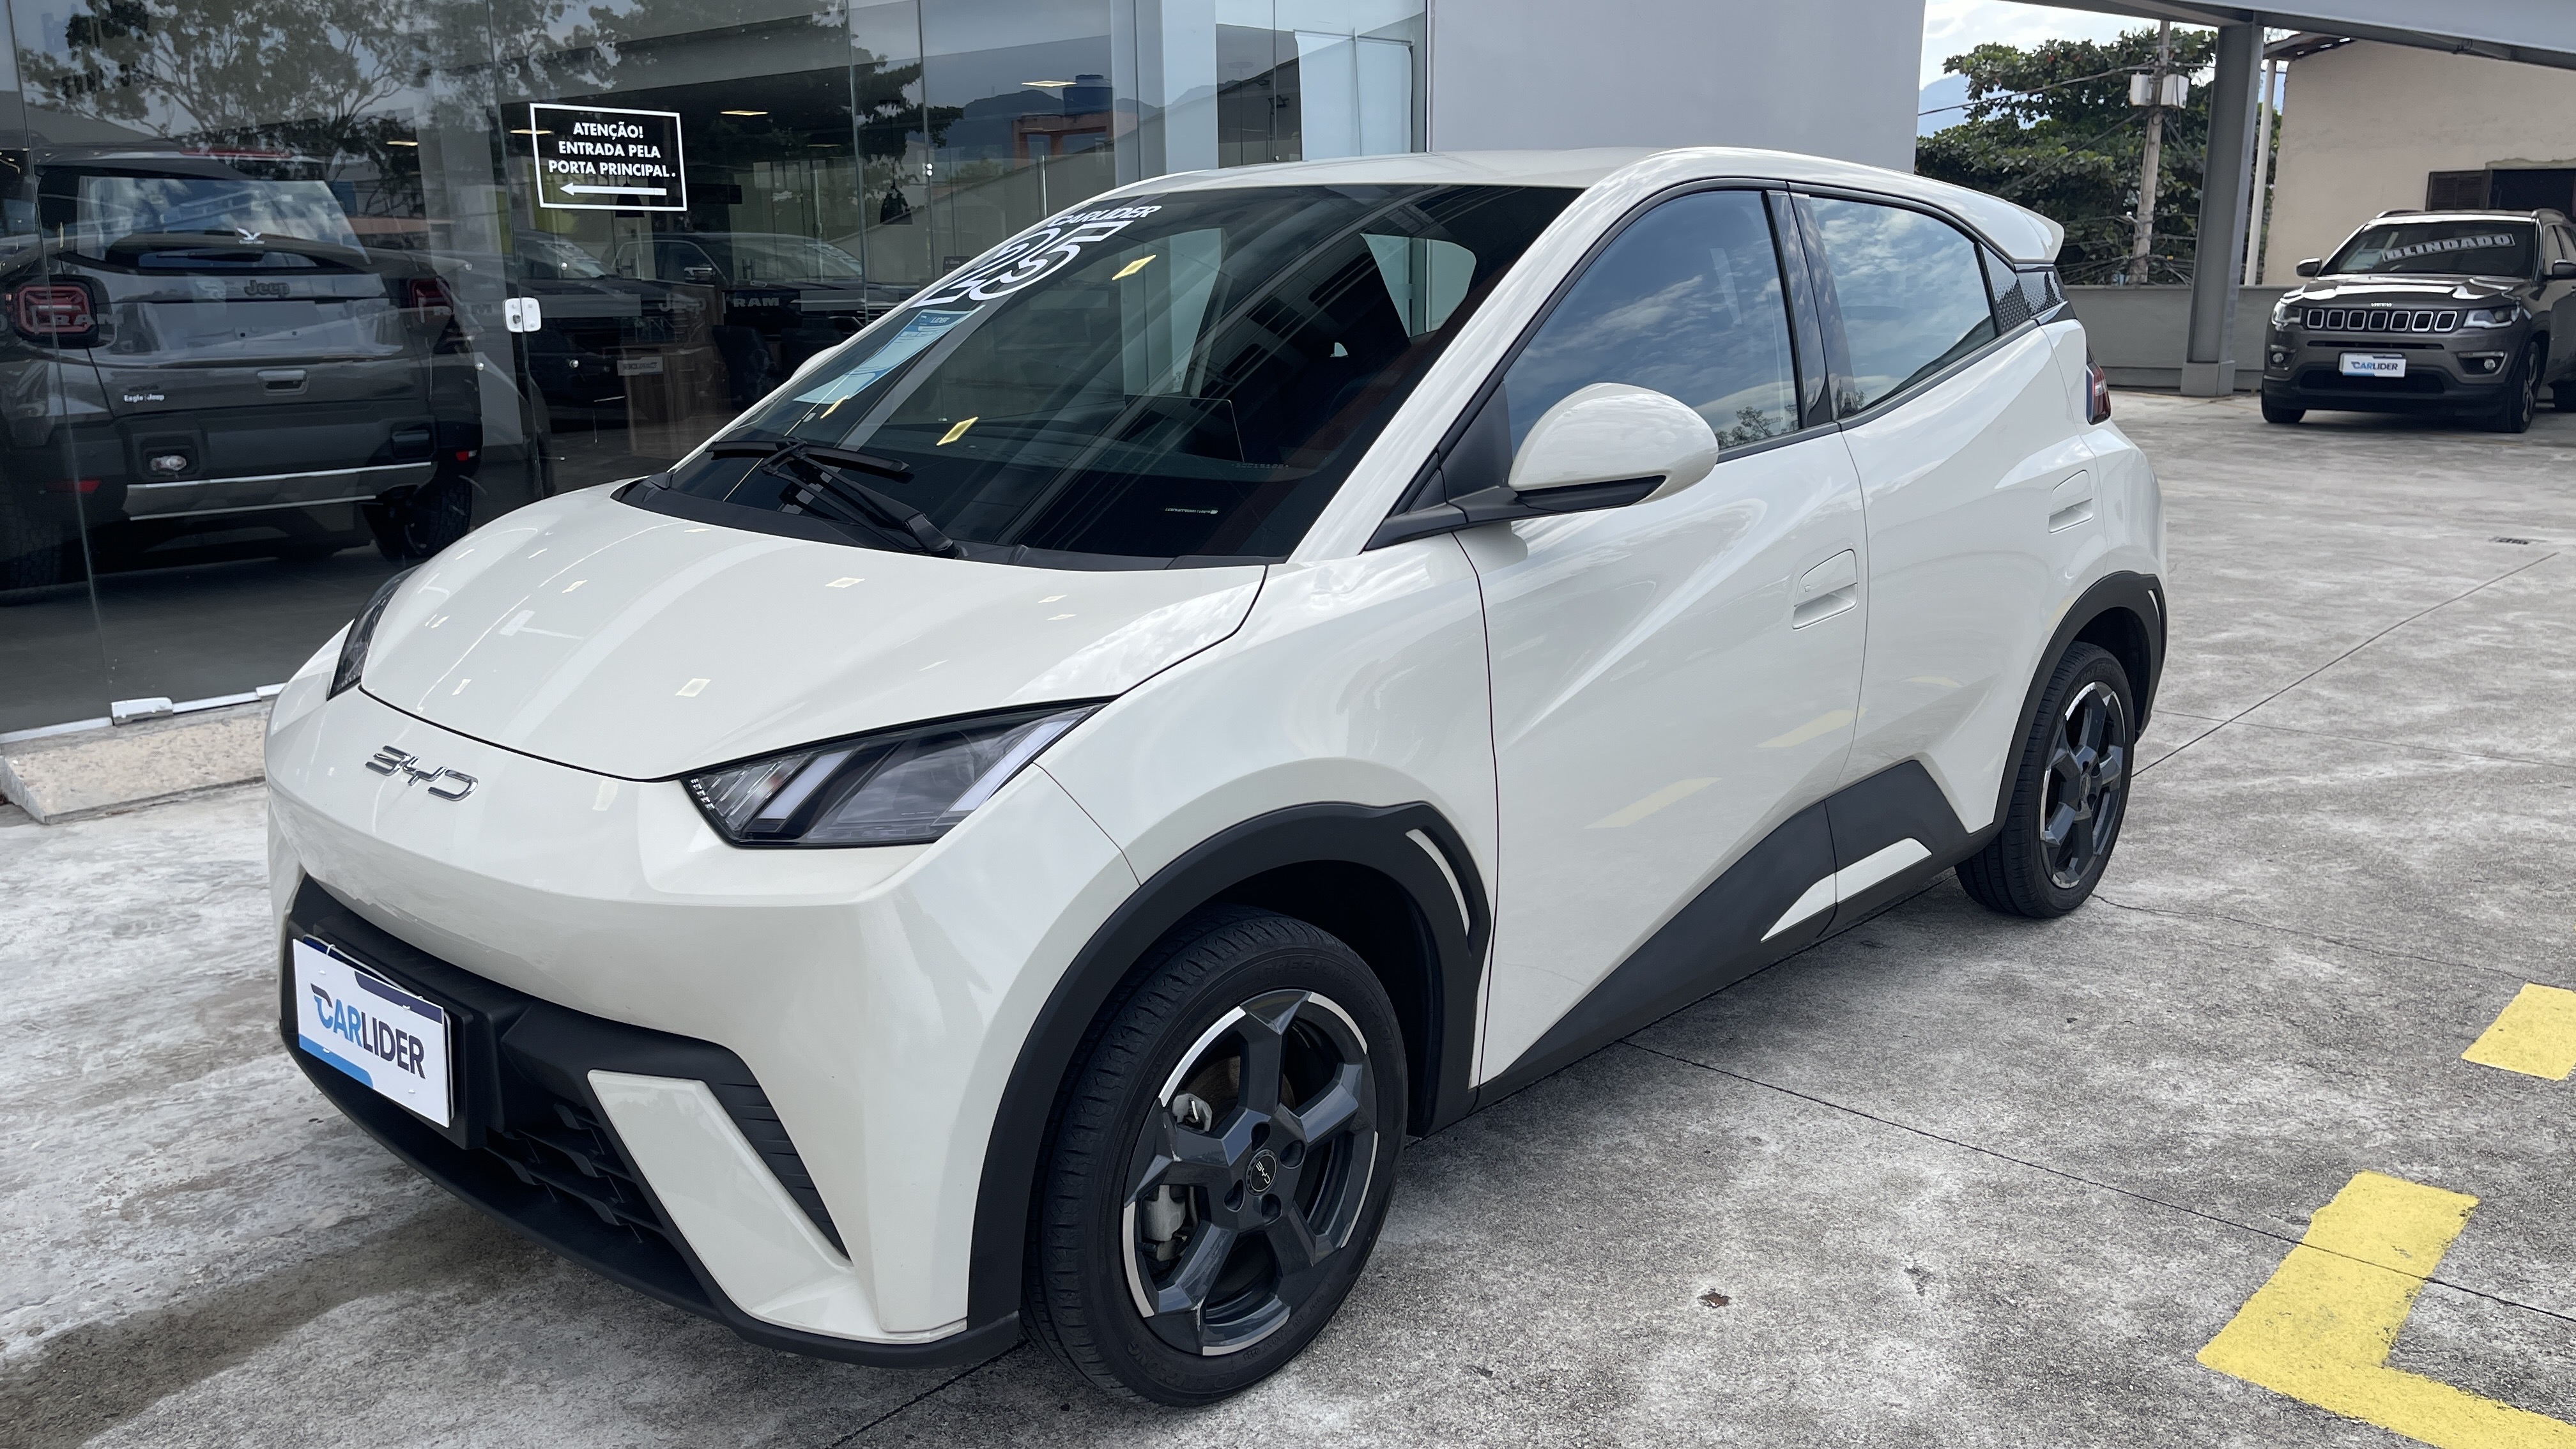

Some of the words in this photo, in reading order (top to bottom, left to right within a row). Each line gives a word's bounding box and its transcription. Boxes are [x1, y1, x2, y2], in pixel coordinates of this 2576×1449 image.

[573, 121, 643, 140] ATENÇÃO!
[558, 141, 625, 157] ENTRADA
[628, 144, 661, 158] PELA
[548, 160, 596, 174] PORTA
[1047, 206, 1162, 227] CARLIDER
[2386, 234, 2510, 259] BLINDADO
[244, 280, 290, 298] Jeep
[733, 298, 779, 307] RAM
[2351, 362, 2398, 371] CARLIDER
[365, 745, 479, 801] BYD
[310, 983, 425, 1079] CARLIDER
[1256, 1161, 1271, 1184] BYD
